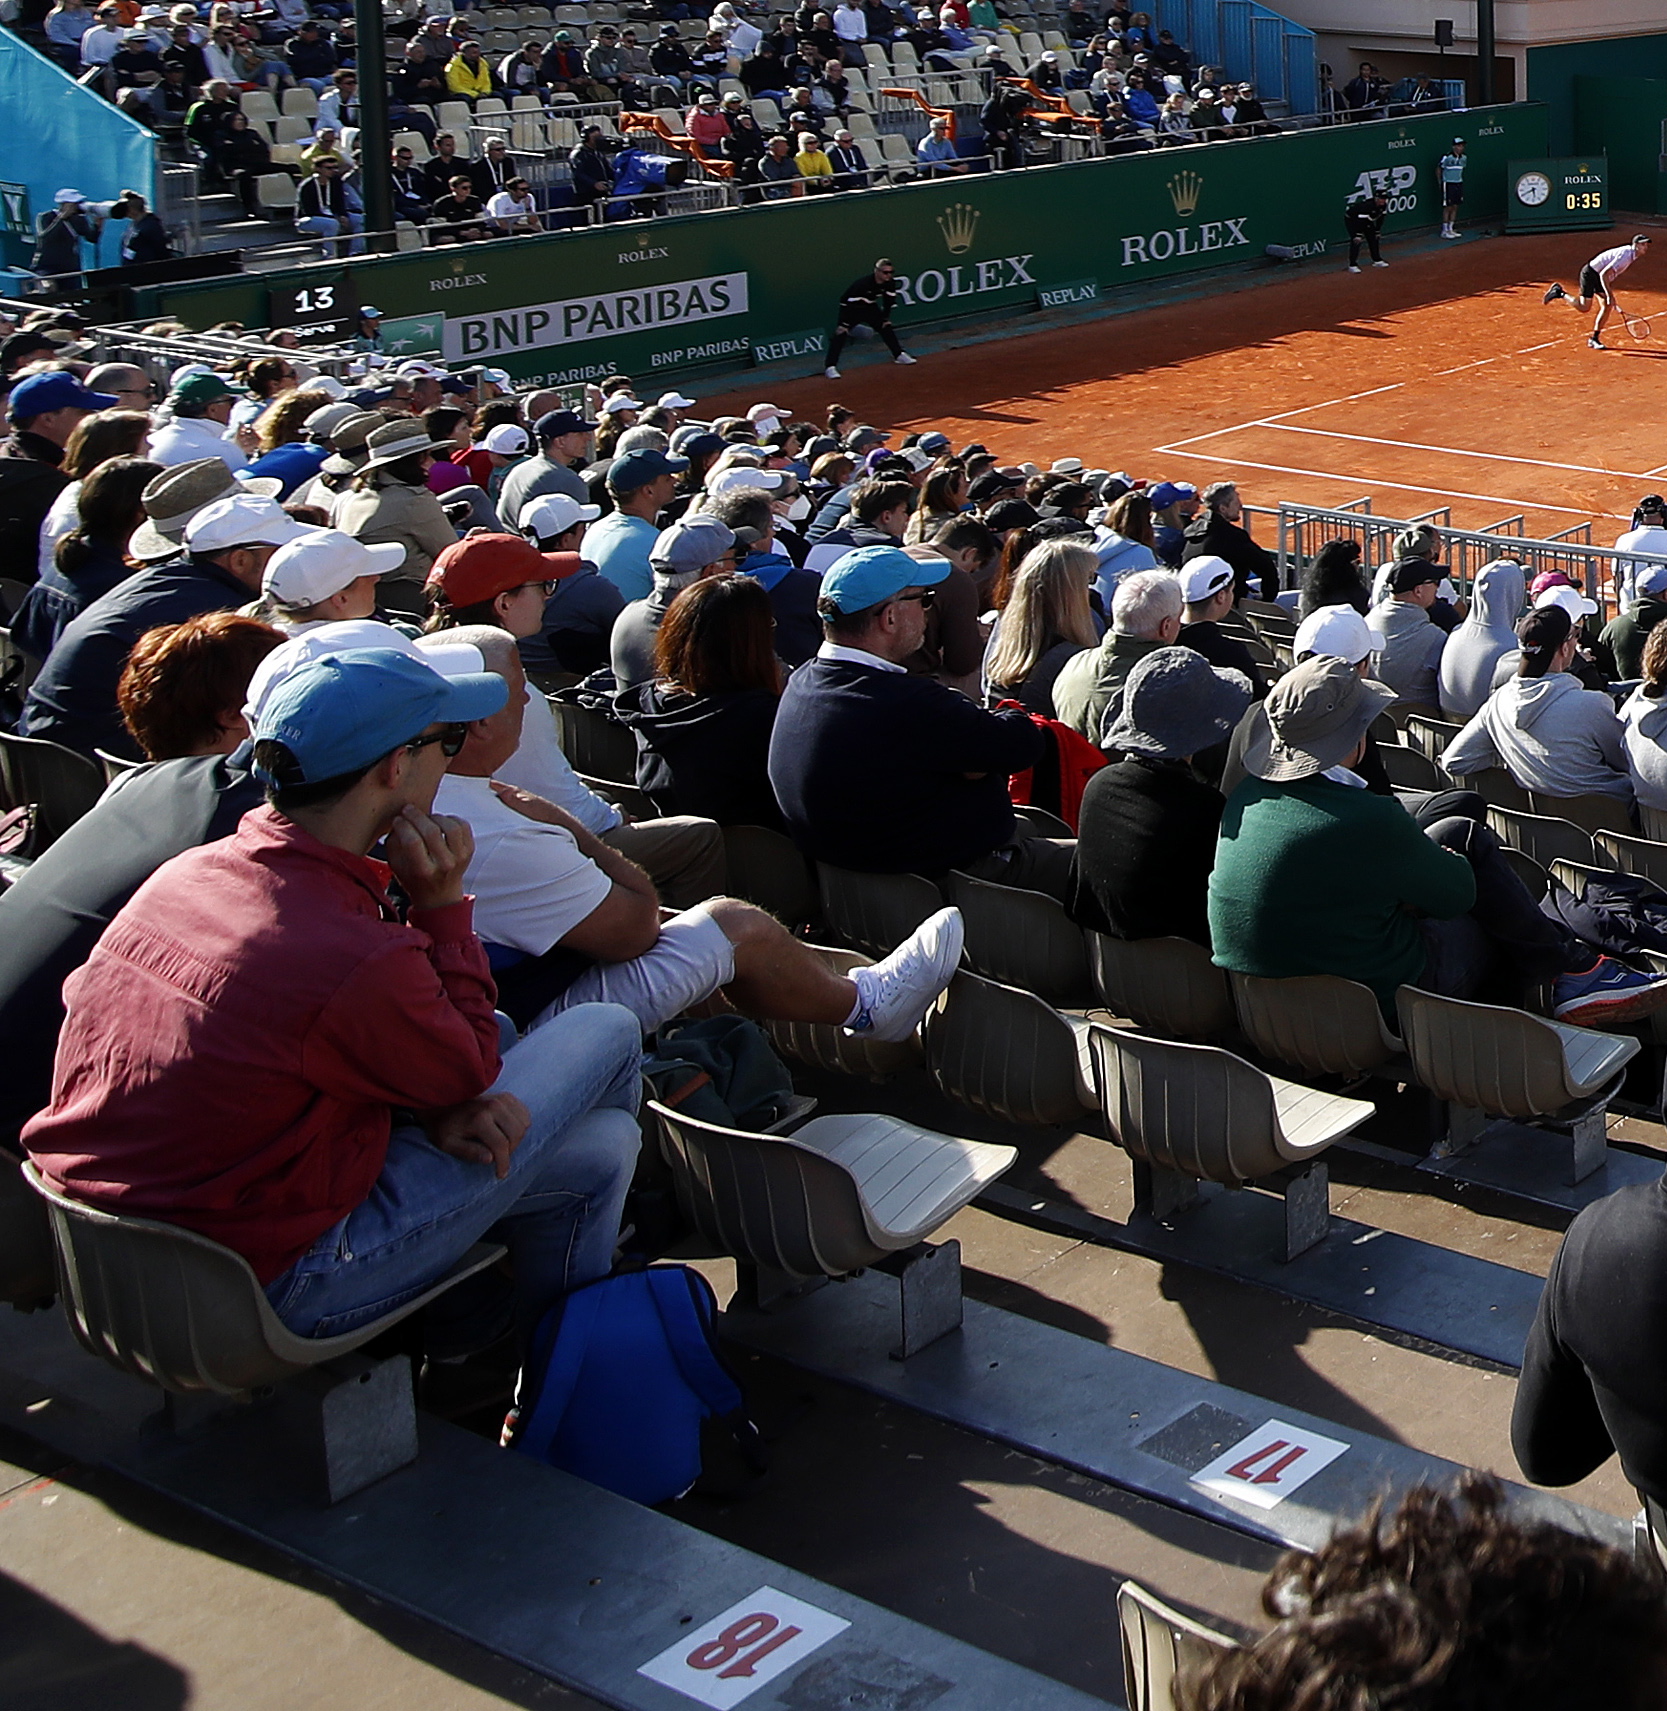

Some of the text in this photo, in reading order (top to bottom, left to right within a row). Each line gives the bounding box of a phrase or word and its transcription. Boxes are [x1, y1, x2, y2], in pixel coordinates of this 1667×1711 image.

[1478, 126, 1504, 137] ROLEX
[1387, 138, 1416, 150] ROLEX
[1564, 174, 1602, 185] ROLEX
[1566, 193, 1601, 210] 0:35
[1121, 217, 1250, 267] ROLEX
[1293, 239, 1327, 259] EPLAY
[618, 247, 669, 264] ROLEX
[430, 273, 488, 292] ROLEX
[893, 254, 1037, 308] ROLEX
[294, 286, 335, 313] 13
[1040, 284, 1096, 308] REPLAY
[461, 279, 731, 356] BNP PARIBAS
[651, 337, 750, 368] BNP PARIBAS
[755, 335, 825, 362] REPLAY
[547, 362, 618, 385] PARIBAS
[1224, 1439, 1309, 1484] 17
[686, 1612, 803, 1679] 18
